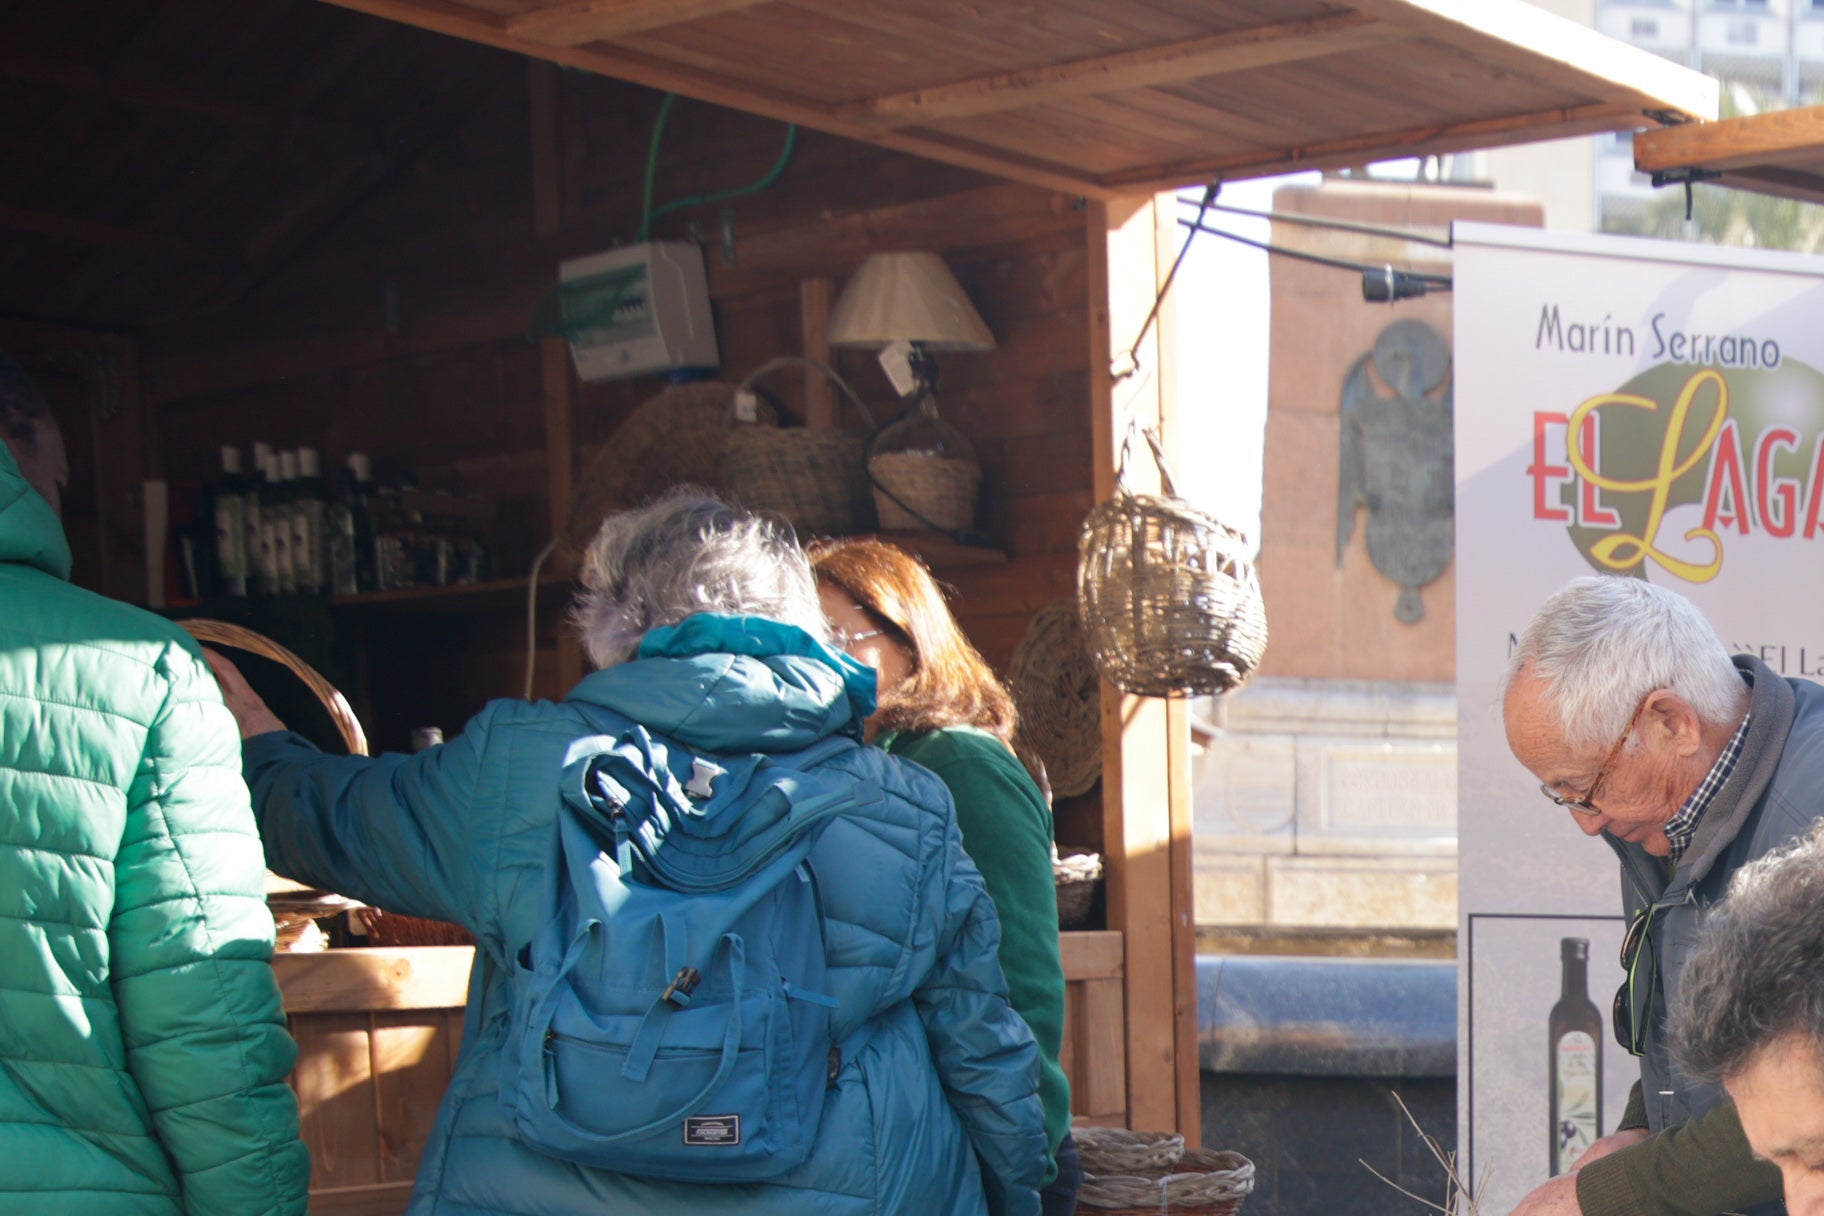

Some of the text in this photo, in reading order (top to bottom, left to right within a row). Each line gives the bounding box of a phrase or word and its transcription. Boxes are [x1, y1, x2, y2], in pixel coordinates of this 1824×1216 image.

[1536, 303, 1781, 368] Marín Serrano
[1527, 410, 1619, 525] EL
